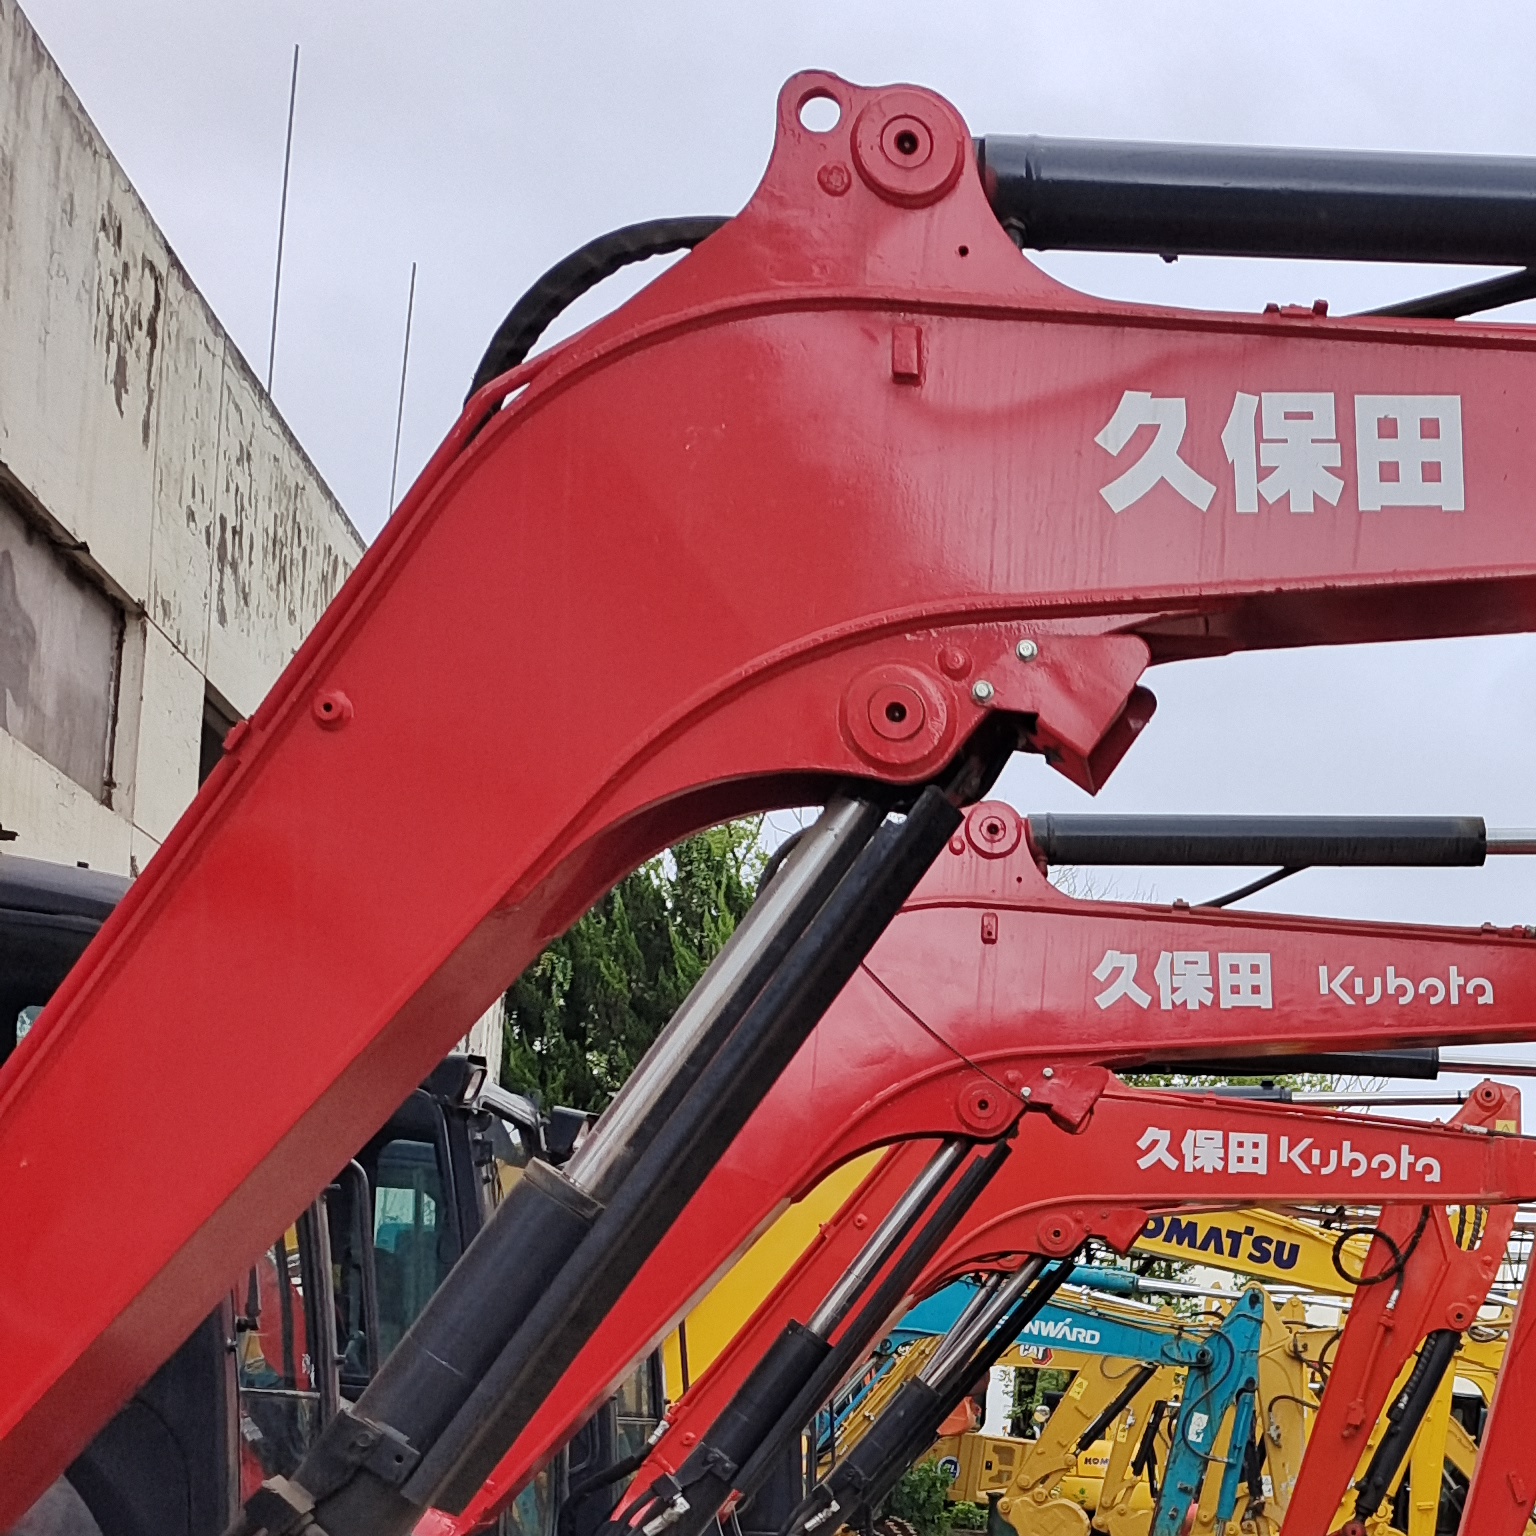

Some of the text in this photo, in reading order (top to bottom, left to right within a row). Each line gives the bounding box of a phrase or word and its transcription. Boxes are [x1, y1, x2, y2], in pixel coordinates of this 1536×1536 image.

[1093, 390, 1466, 514] 久保田
[1092, 949, 1494, 1010] 久保田 Kubota
[1136, 1126, 1441, 1183] 久保田 Kubota
[1141, 1216, 1300, 1270] OMATSU
[1019, 1344, 1046, 1360] CAT
[1020, 1317, 1101, 1345] NWARD
